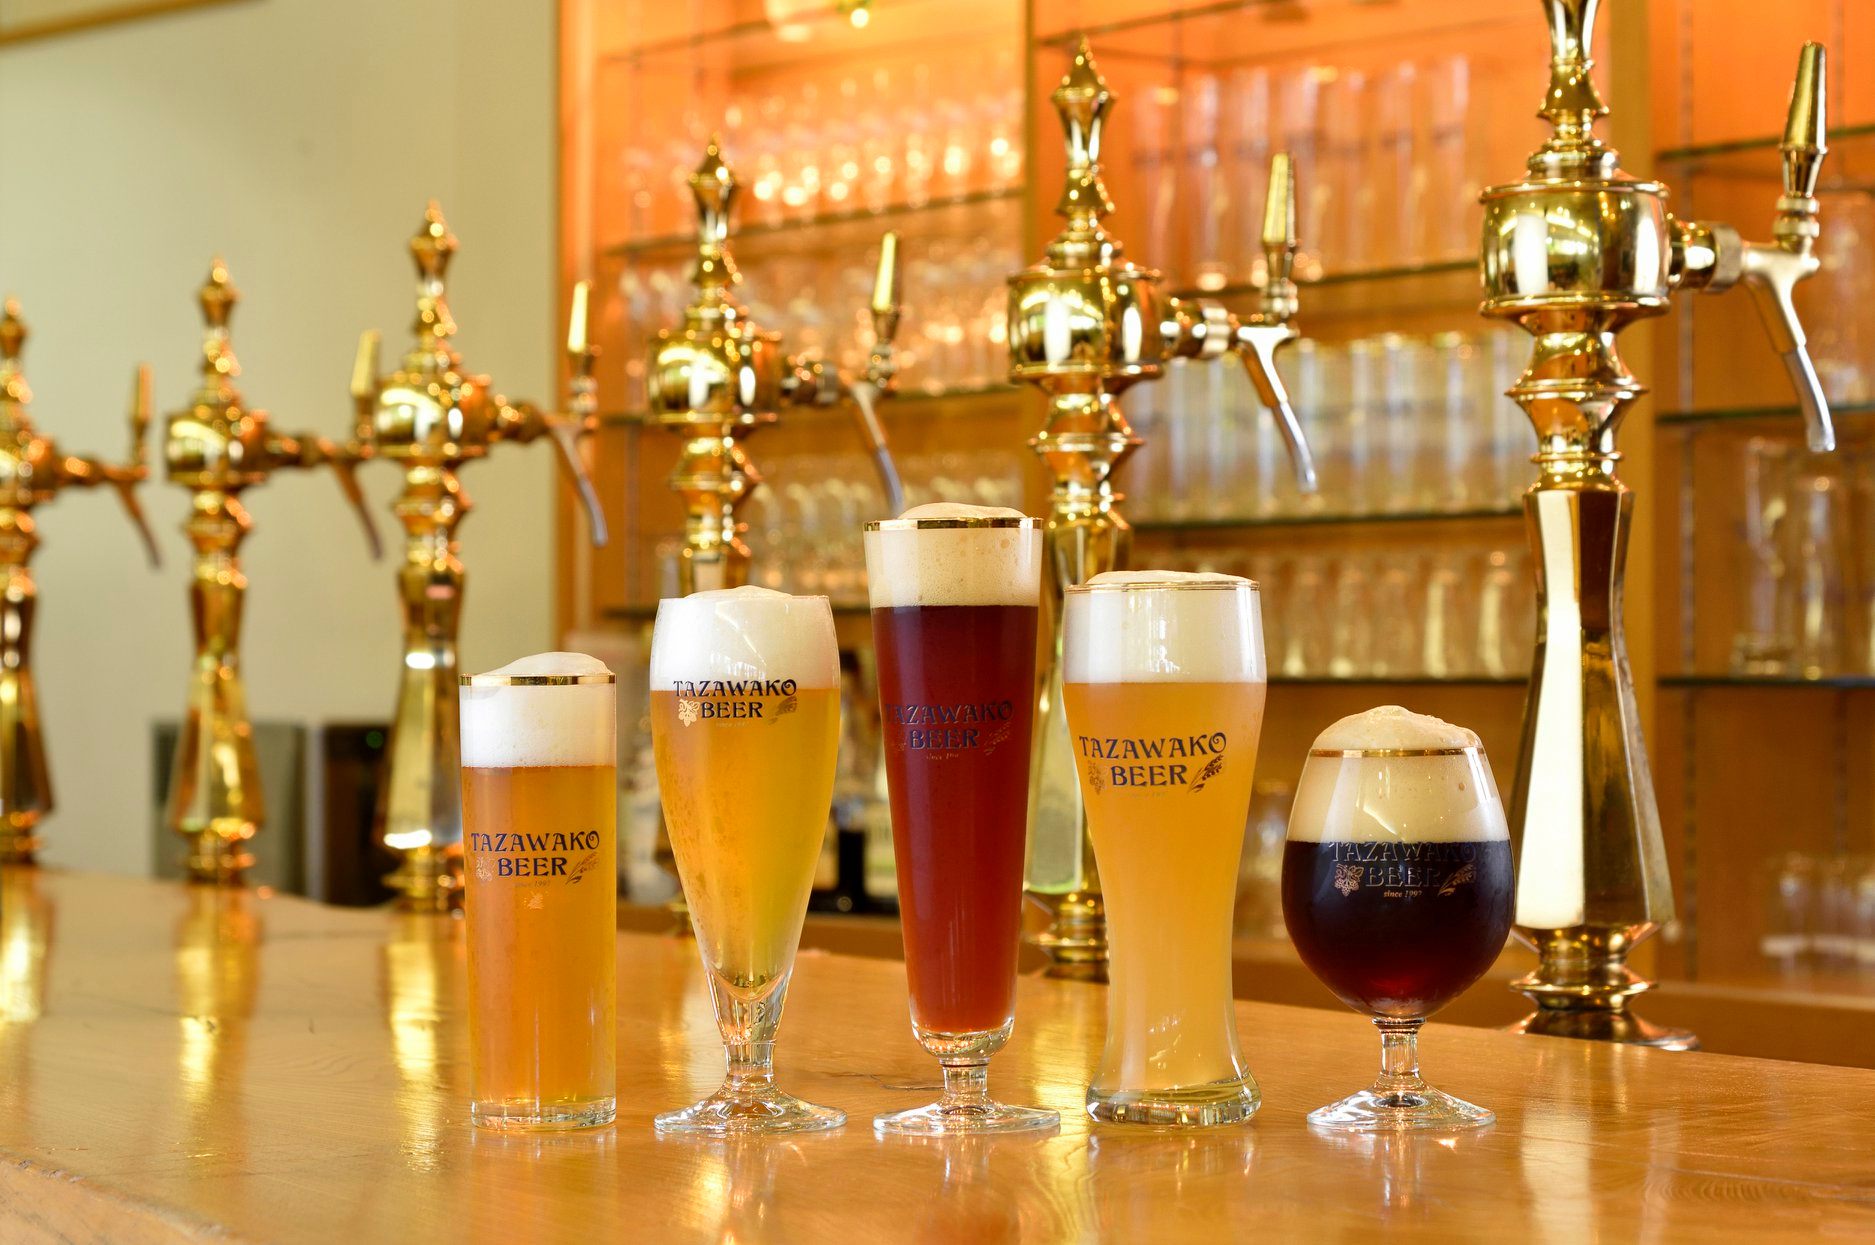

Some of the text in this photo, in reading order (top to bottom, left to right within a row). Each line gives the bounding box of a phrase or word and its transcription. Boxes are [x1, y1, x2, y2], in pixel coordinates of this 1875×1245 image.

[673, 679, 797, 697] TAZAWAKO
[701, 701, 763, 718] BEER
[885, 700, 1014, 725] TAZAWAKO
[909, 728, 980, 750] BEER
[1079, 732, 1227, 759] TAZAWAKO
[1111, 764, 1188, 786] BEER
[470, 830, 600, 852] TAZAWAKO
[497, 857, 568, 877] BEER
[1365, 866, 1441, 887] BEER
[1383, 889, 1403, 898] since
